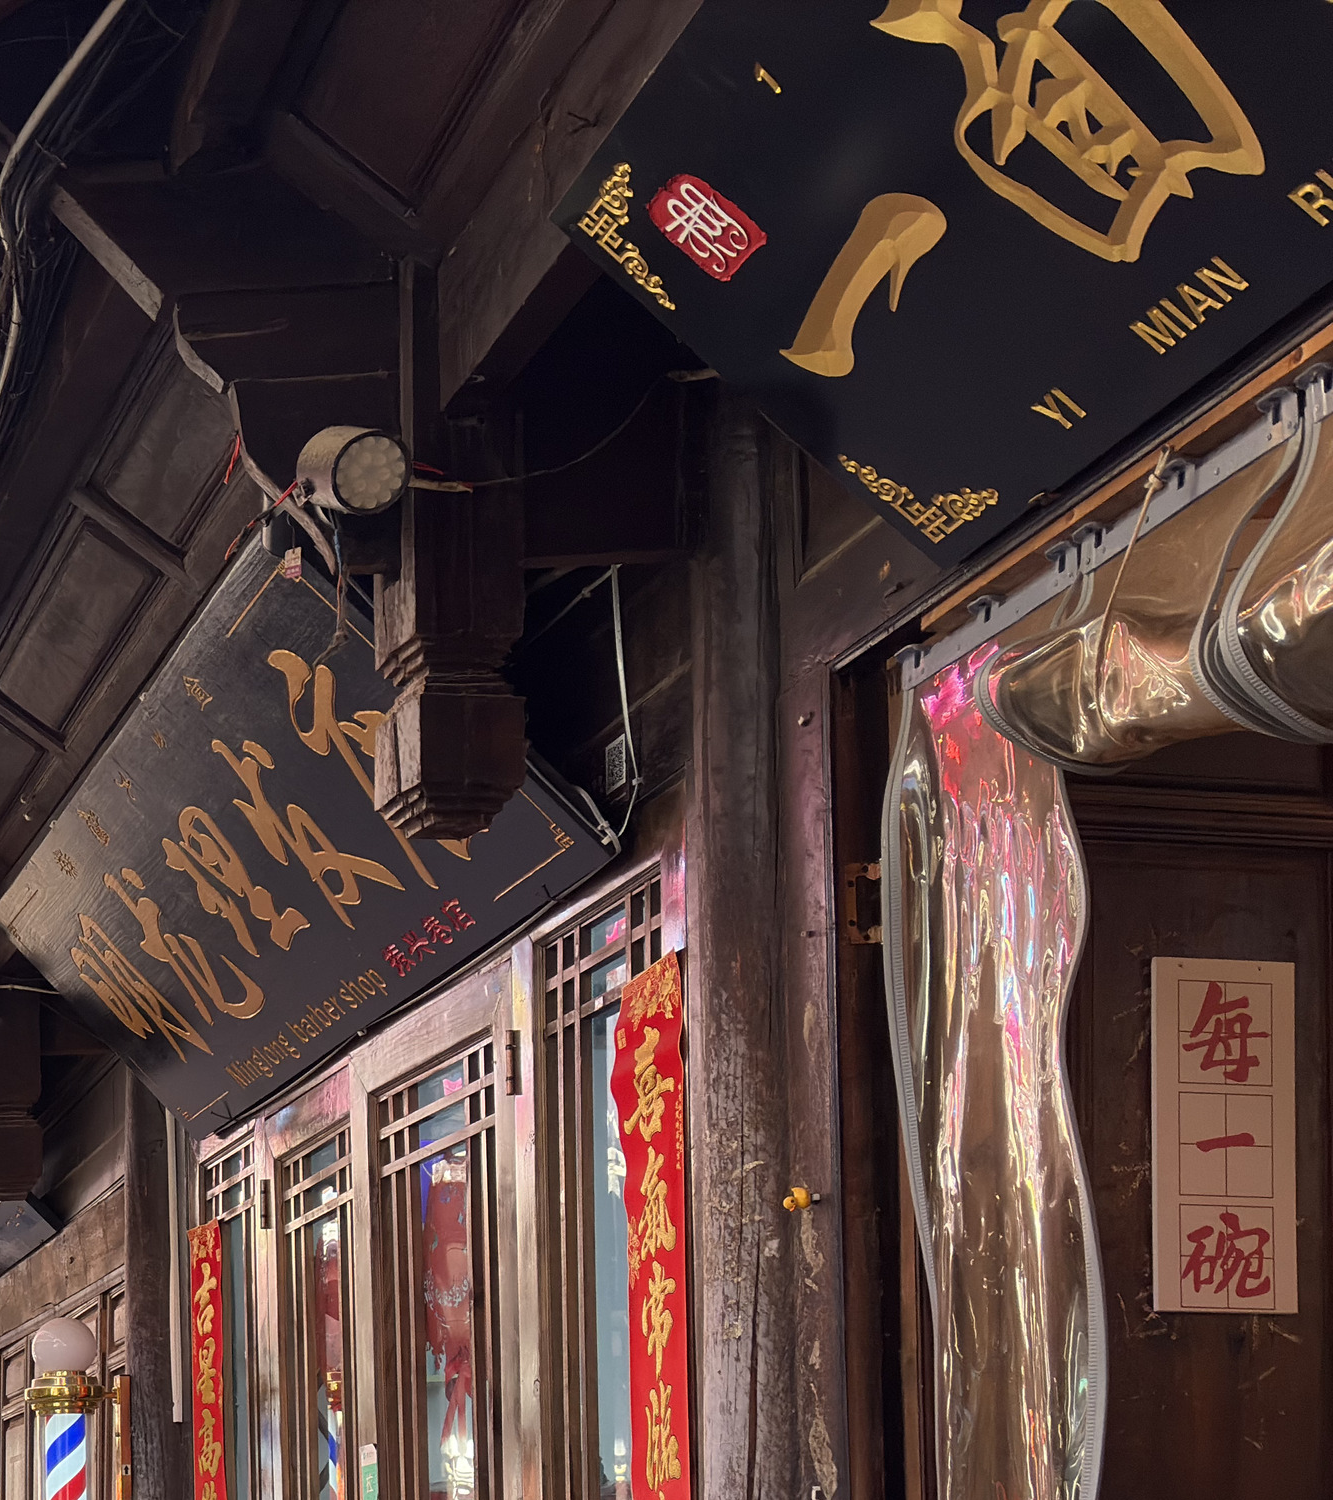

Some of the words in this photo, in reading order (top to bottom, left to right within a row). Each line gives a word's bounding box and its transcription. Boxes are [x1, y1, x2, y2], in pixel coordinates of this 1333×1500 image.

[1031, 386, 1087, 430] YI
[1129, 255, 1249, 355] MIAN
[1287, 168, 1333, 227] R
[226, 1034, 300, 1086] Minglong
[287, 997, 345, 1042] barber
[340, 969, 387, 1008] shop
[383, 899, 475, 976] 振兴巷店
[1181, 980, 1271, 1299] 每一碗
